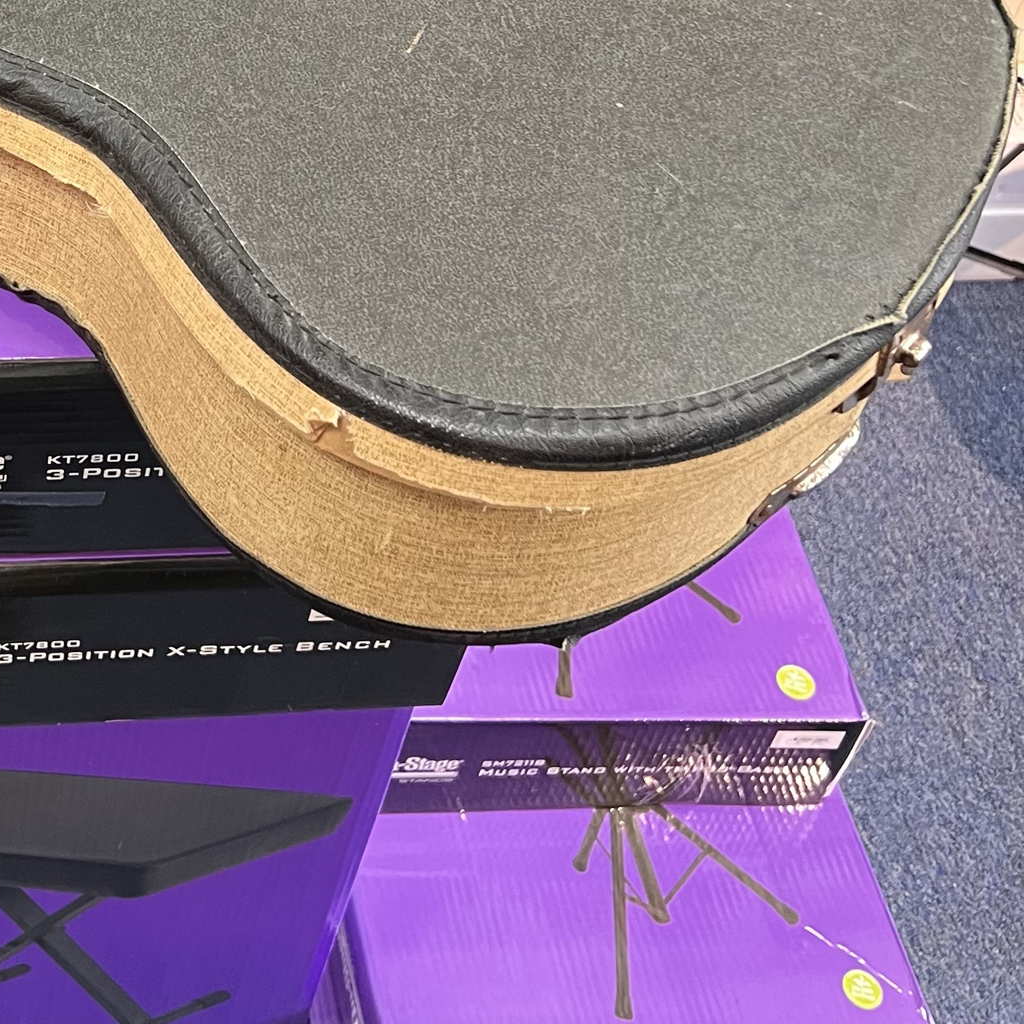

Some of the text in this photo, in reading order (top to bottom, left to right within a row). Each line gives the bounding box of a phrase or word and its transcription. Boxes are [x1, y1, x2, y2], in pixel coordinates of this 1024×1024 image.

[47, 453, 139, 465] KT7800
[295, 639, 391, 652] BENCH
[478, 767, 539, 777] MUSIC
[546, 766, 606, 776] STAND
